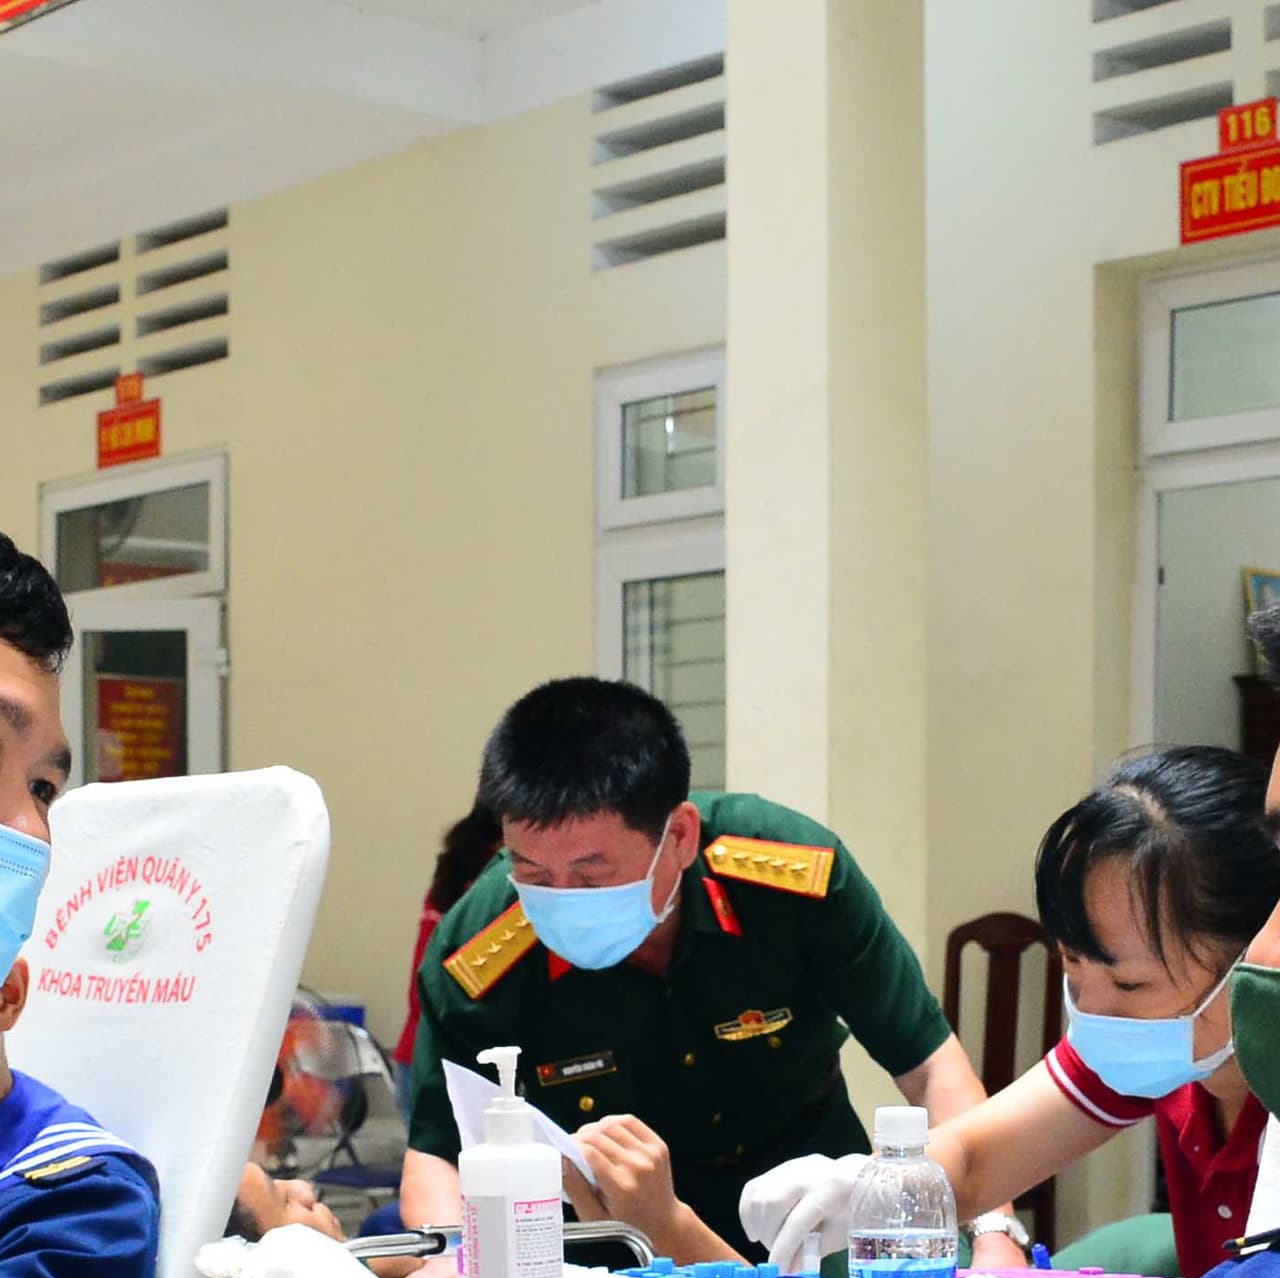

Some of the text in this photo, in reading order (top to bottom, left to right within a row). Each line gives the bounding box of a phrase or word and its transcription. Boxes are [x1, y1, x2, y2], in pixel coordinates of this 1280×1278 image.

[1227, 105, 1272, 143] 116
[96, 855, 139, 892] VIỆN
[141, 855, 192, 896] QUÂN
[185, 878, 202, 905] Y
[192, 897, 213, 953] 175
[37, 967, 83, 998] KHOA
[151, 969, 196, 1004] MÁU
